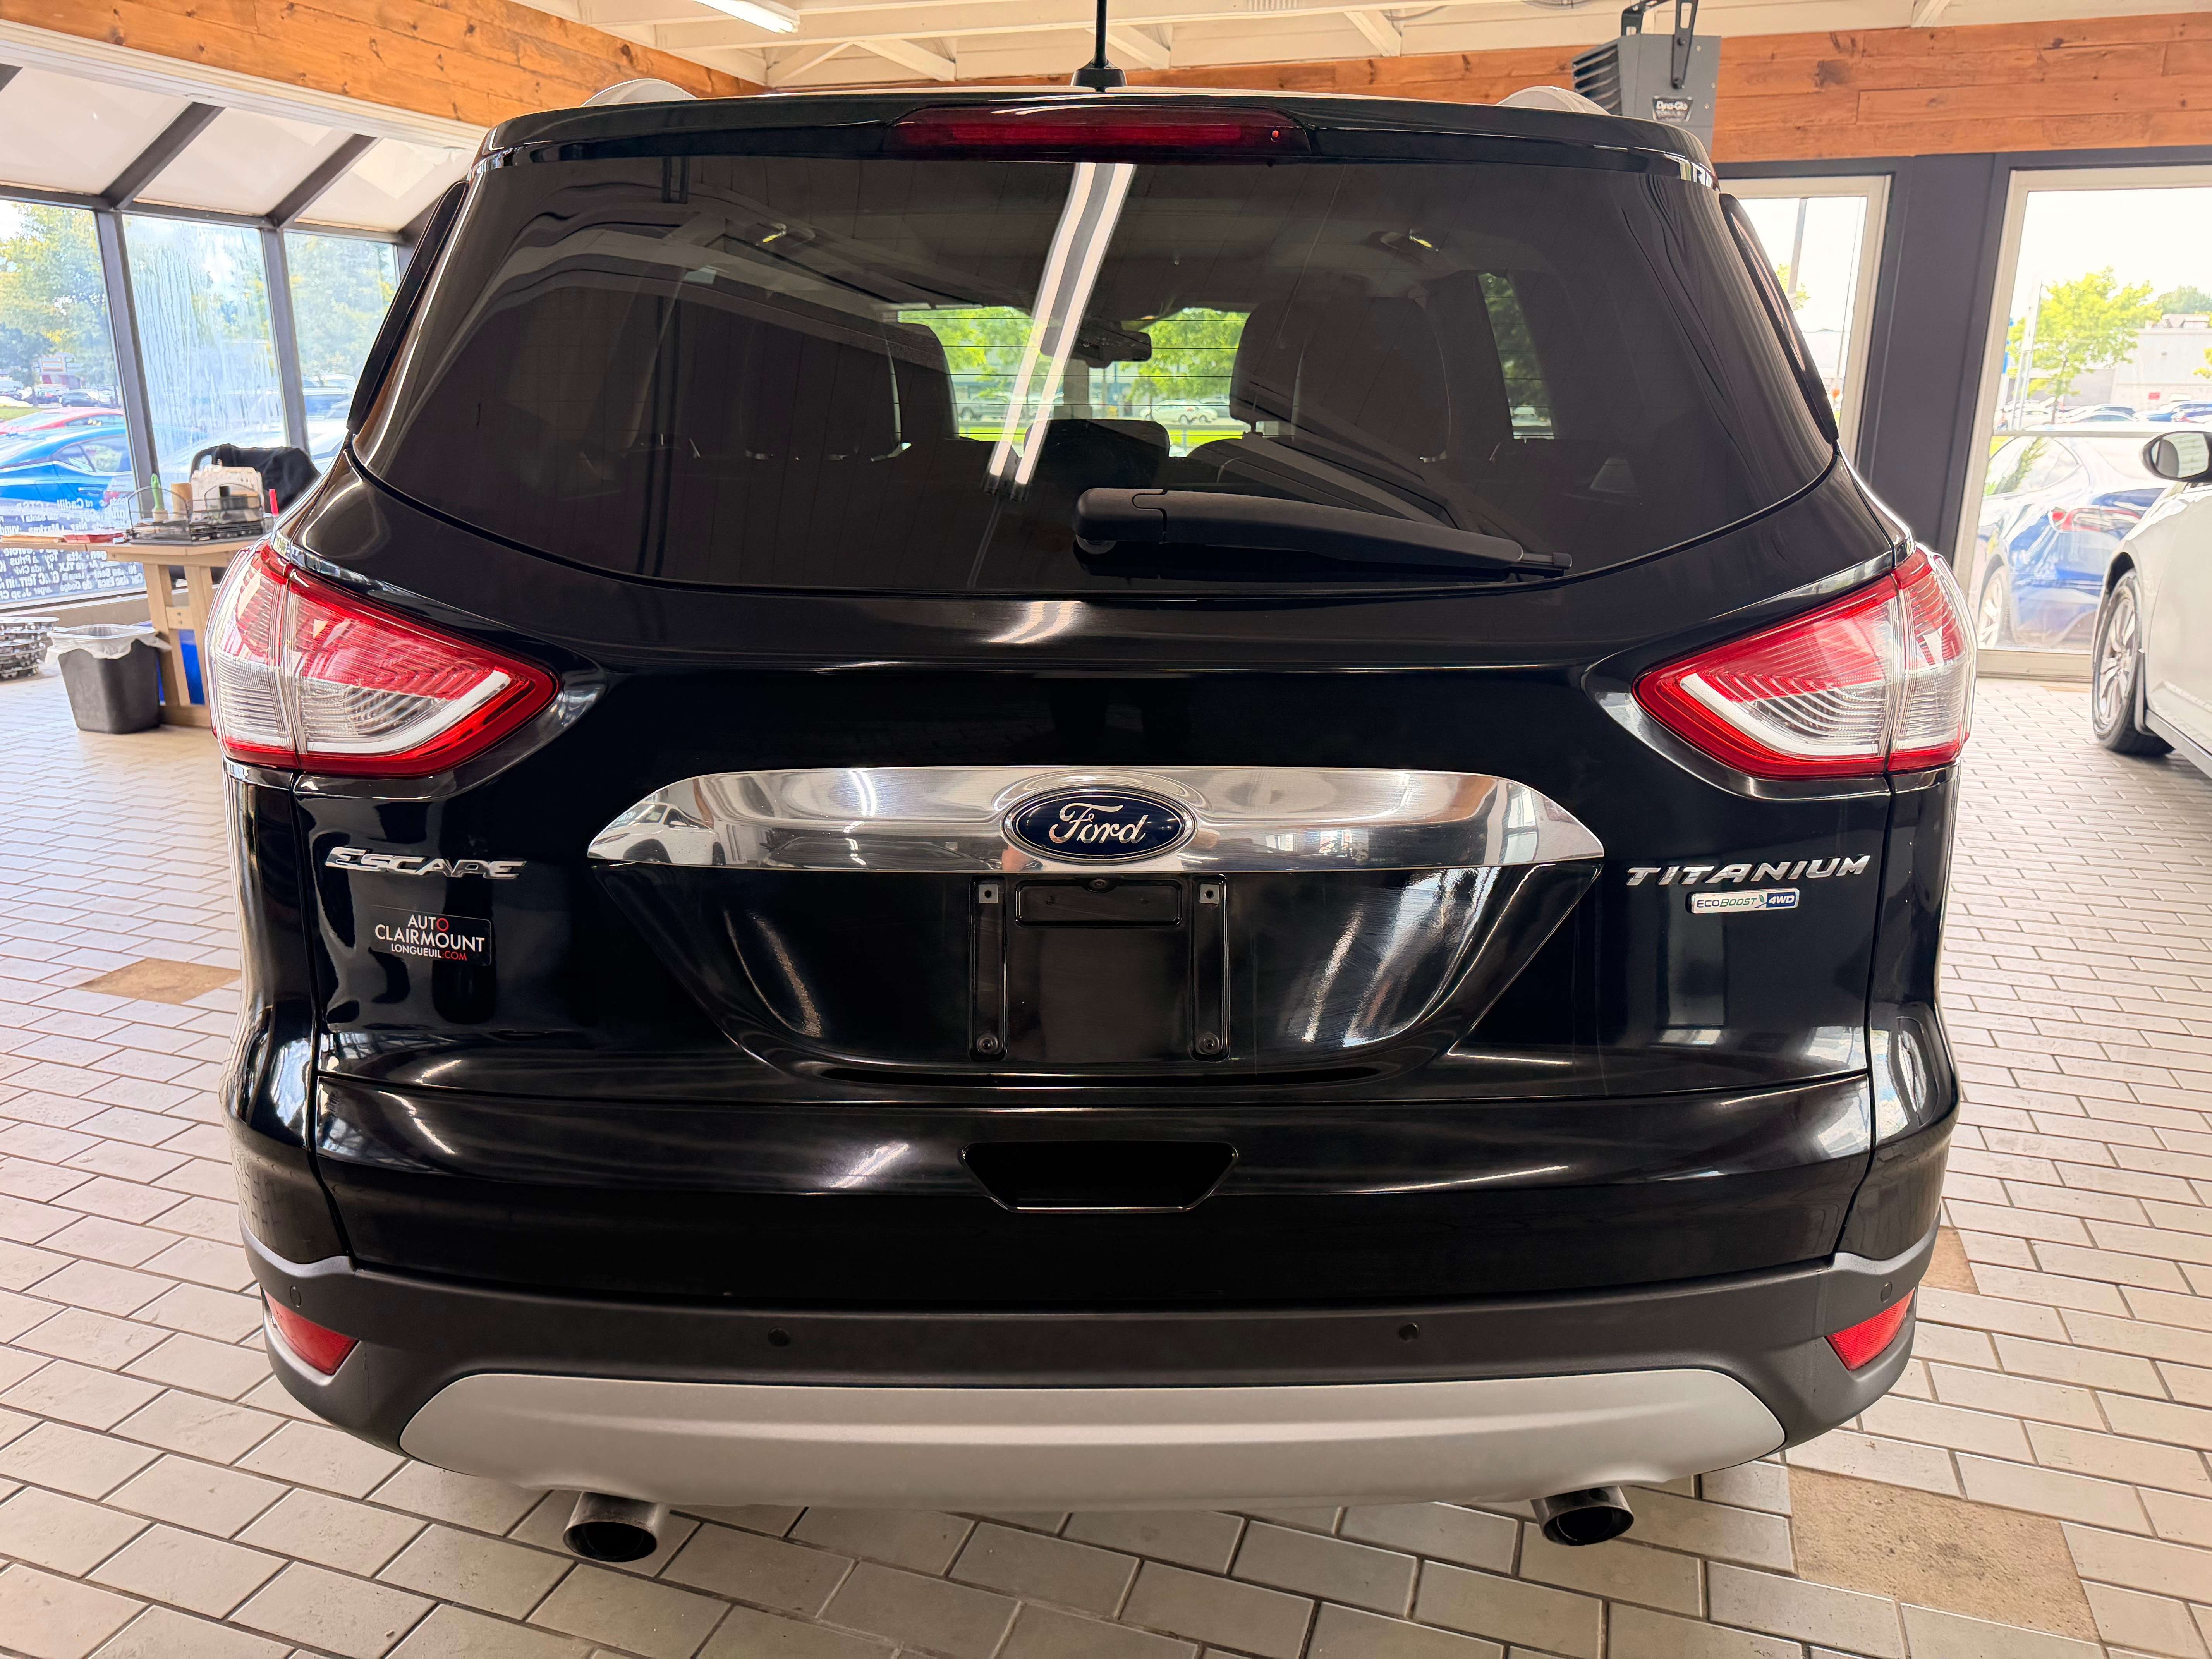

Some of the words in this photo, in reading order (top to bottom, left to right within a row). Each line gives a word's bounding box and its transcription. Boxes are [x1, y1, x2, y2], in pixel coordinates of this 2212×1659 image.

[1049, 802, 1149, 844] Ford
[325, 846, 527, 879] ESCAPE
[1626, 855, 1870, 886] TITANIUM
[1768, 894, 1795, 905] 4WD
[407, 914, 449, 931] AUTO
[375, 924, 484, 952] CLAIRMOUNT
[391, 943, 467, 961] LONGUEUIL.COM
